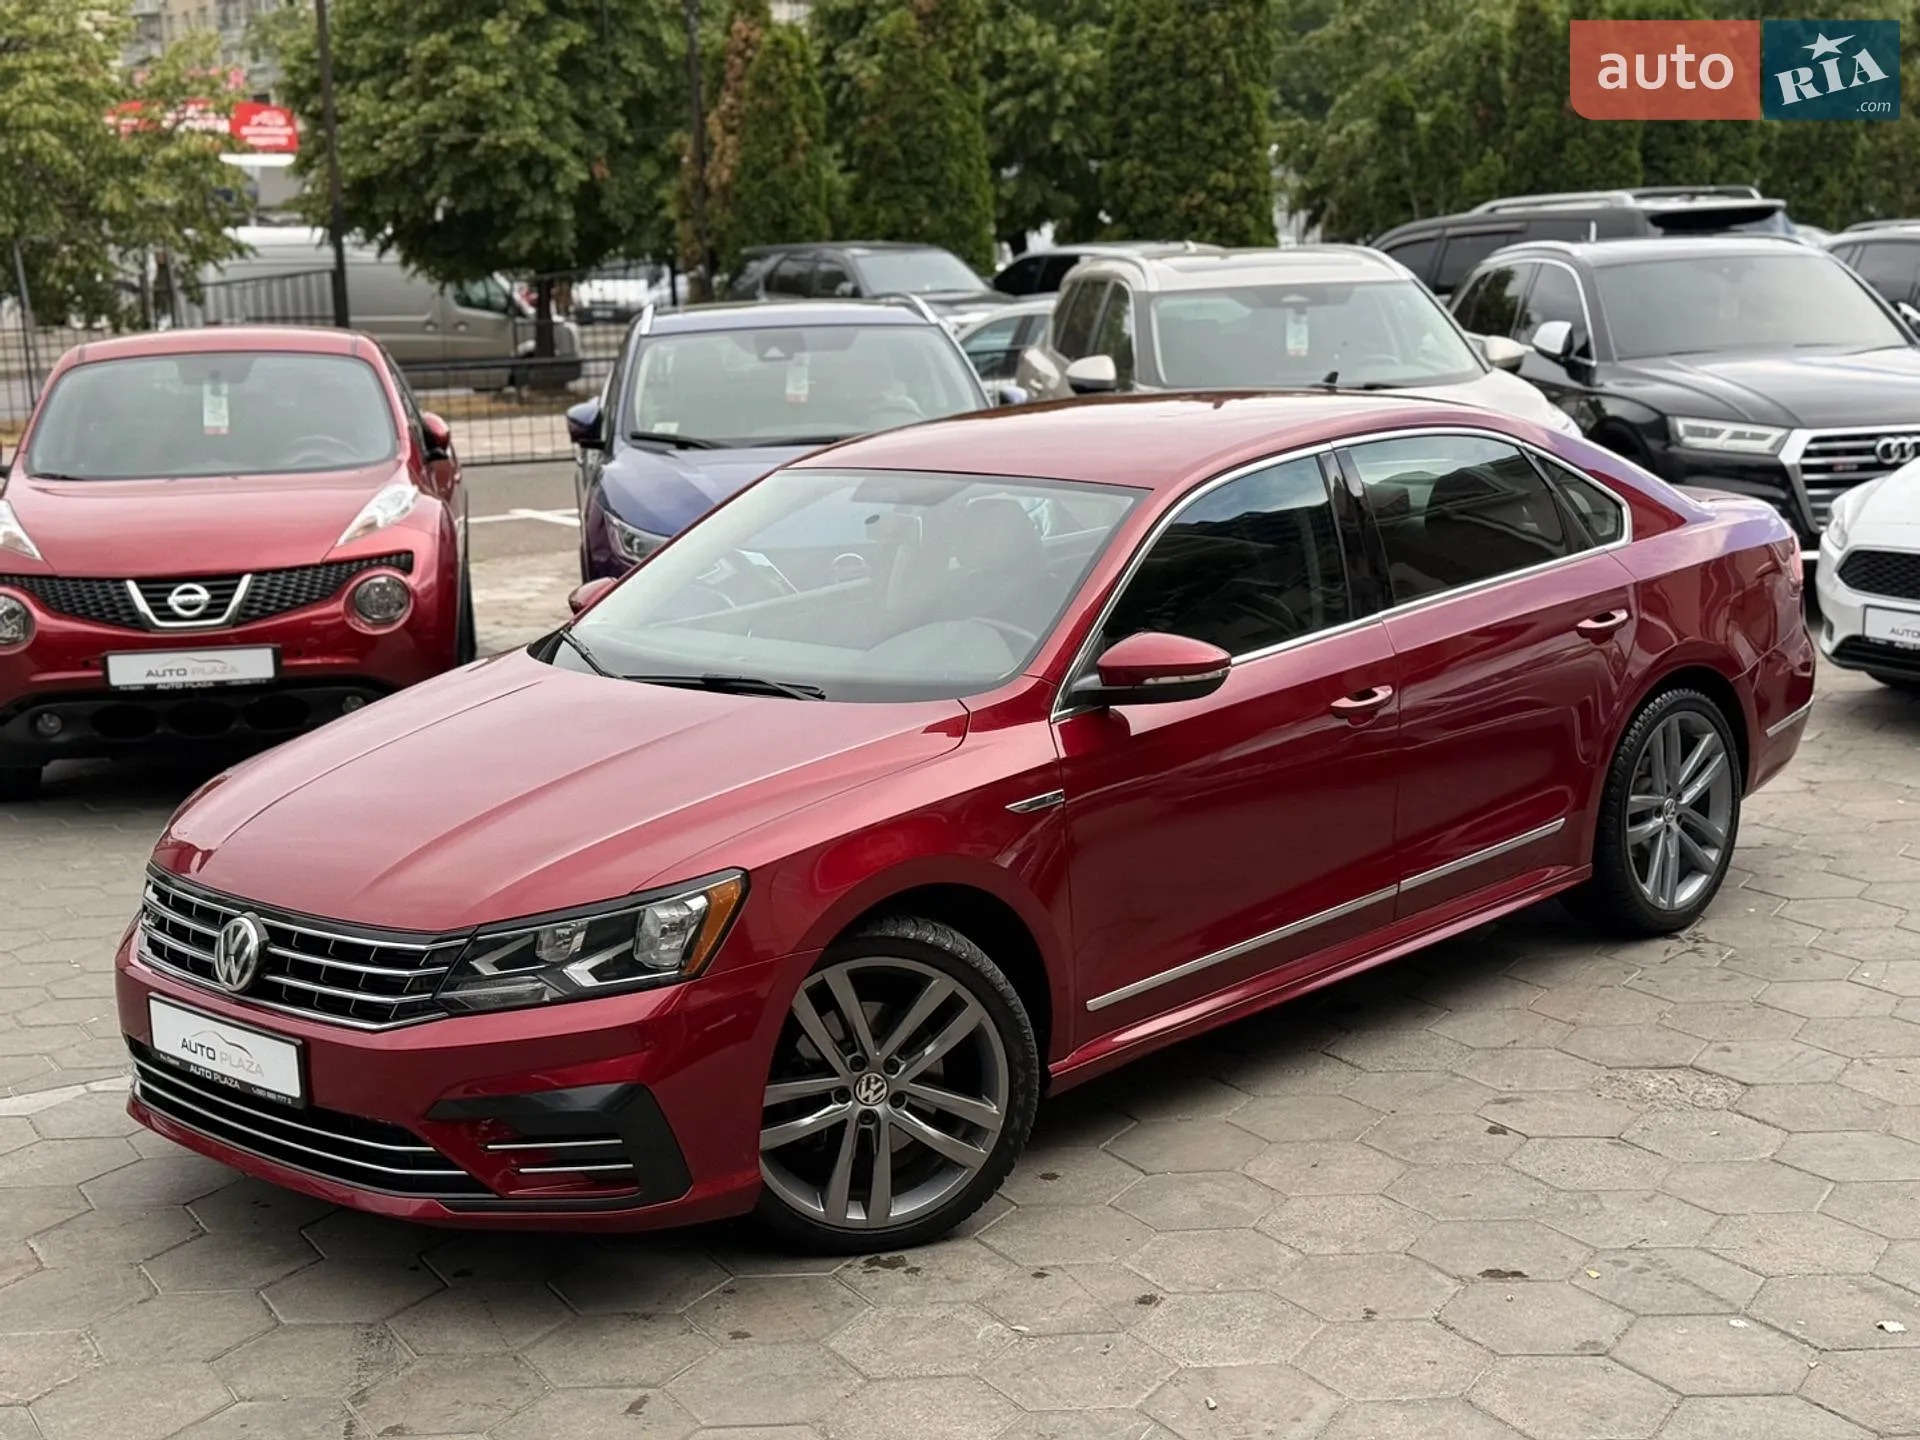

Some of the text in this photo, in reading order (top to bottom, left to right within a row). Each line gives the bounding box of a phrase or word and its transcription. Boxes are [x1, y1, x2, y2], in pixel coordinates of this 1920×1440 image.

[145, 666, 239, 679] AUTO PLAZA
[156, 682, 183, 690] AUTO
[181, 1037, 216, 1061] AUTO
[219, 1051, 265, 1077] PLAZA
[189, 1063, 241, 1090] AUTO PLAZA
